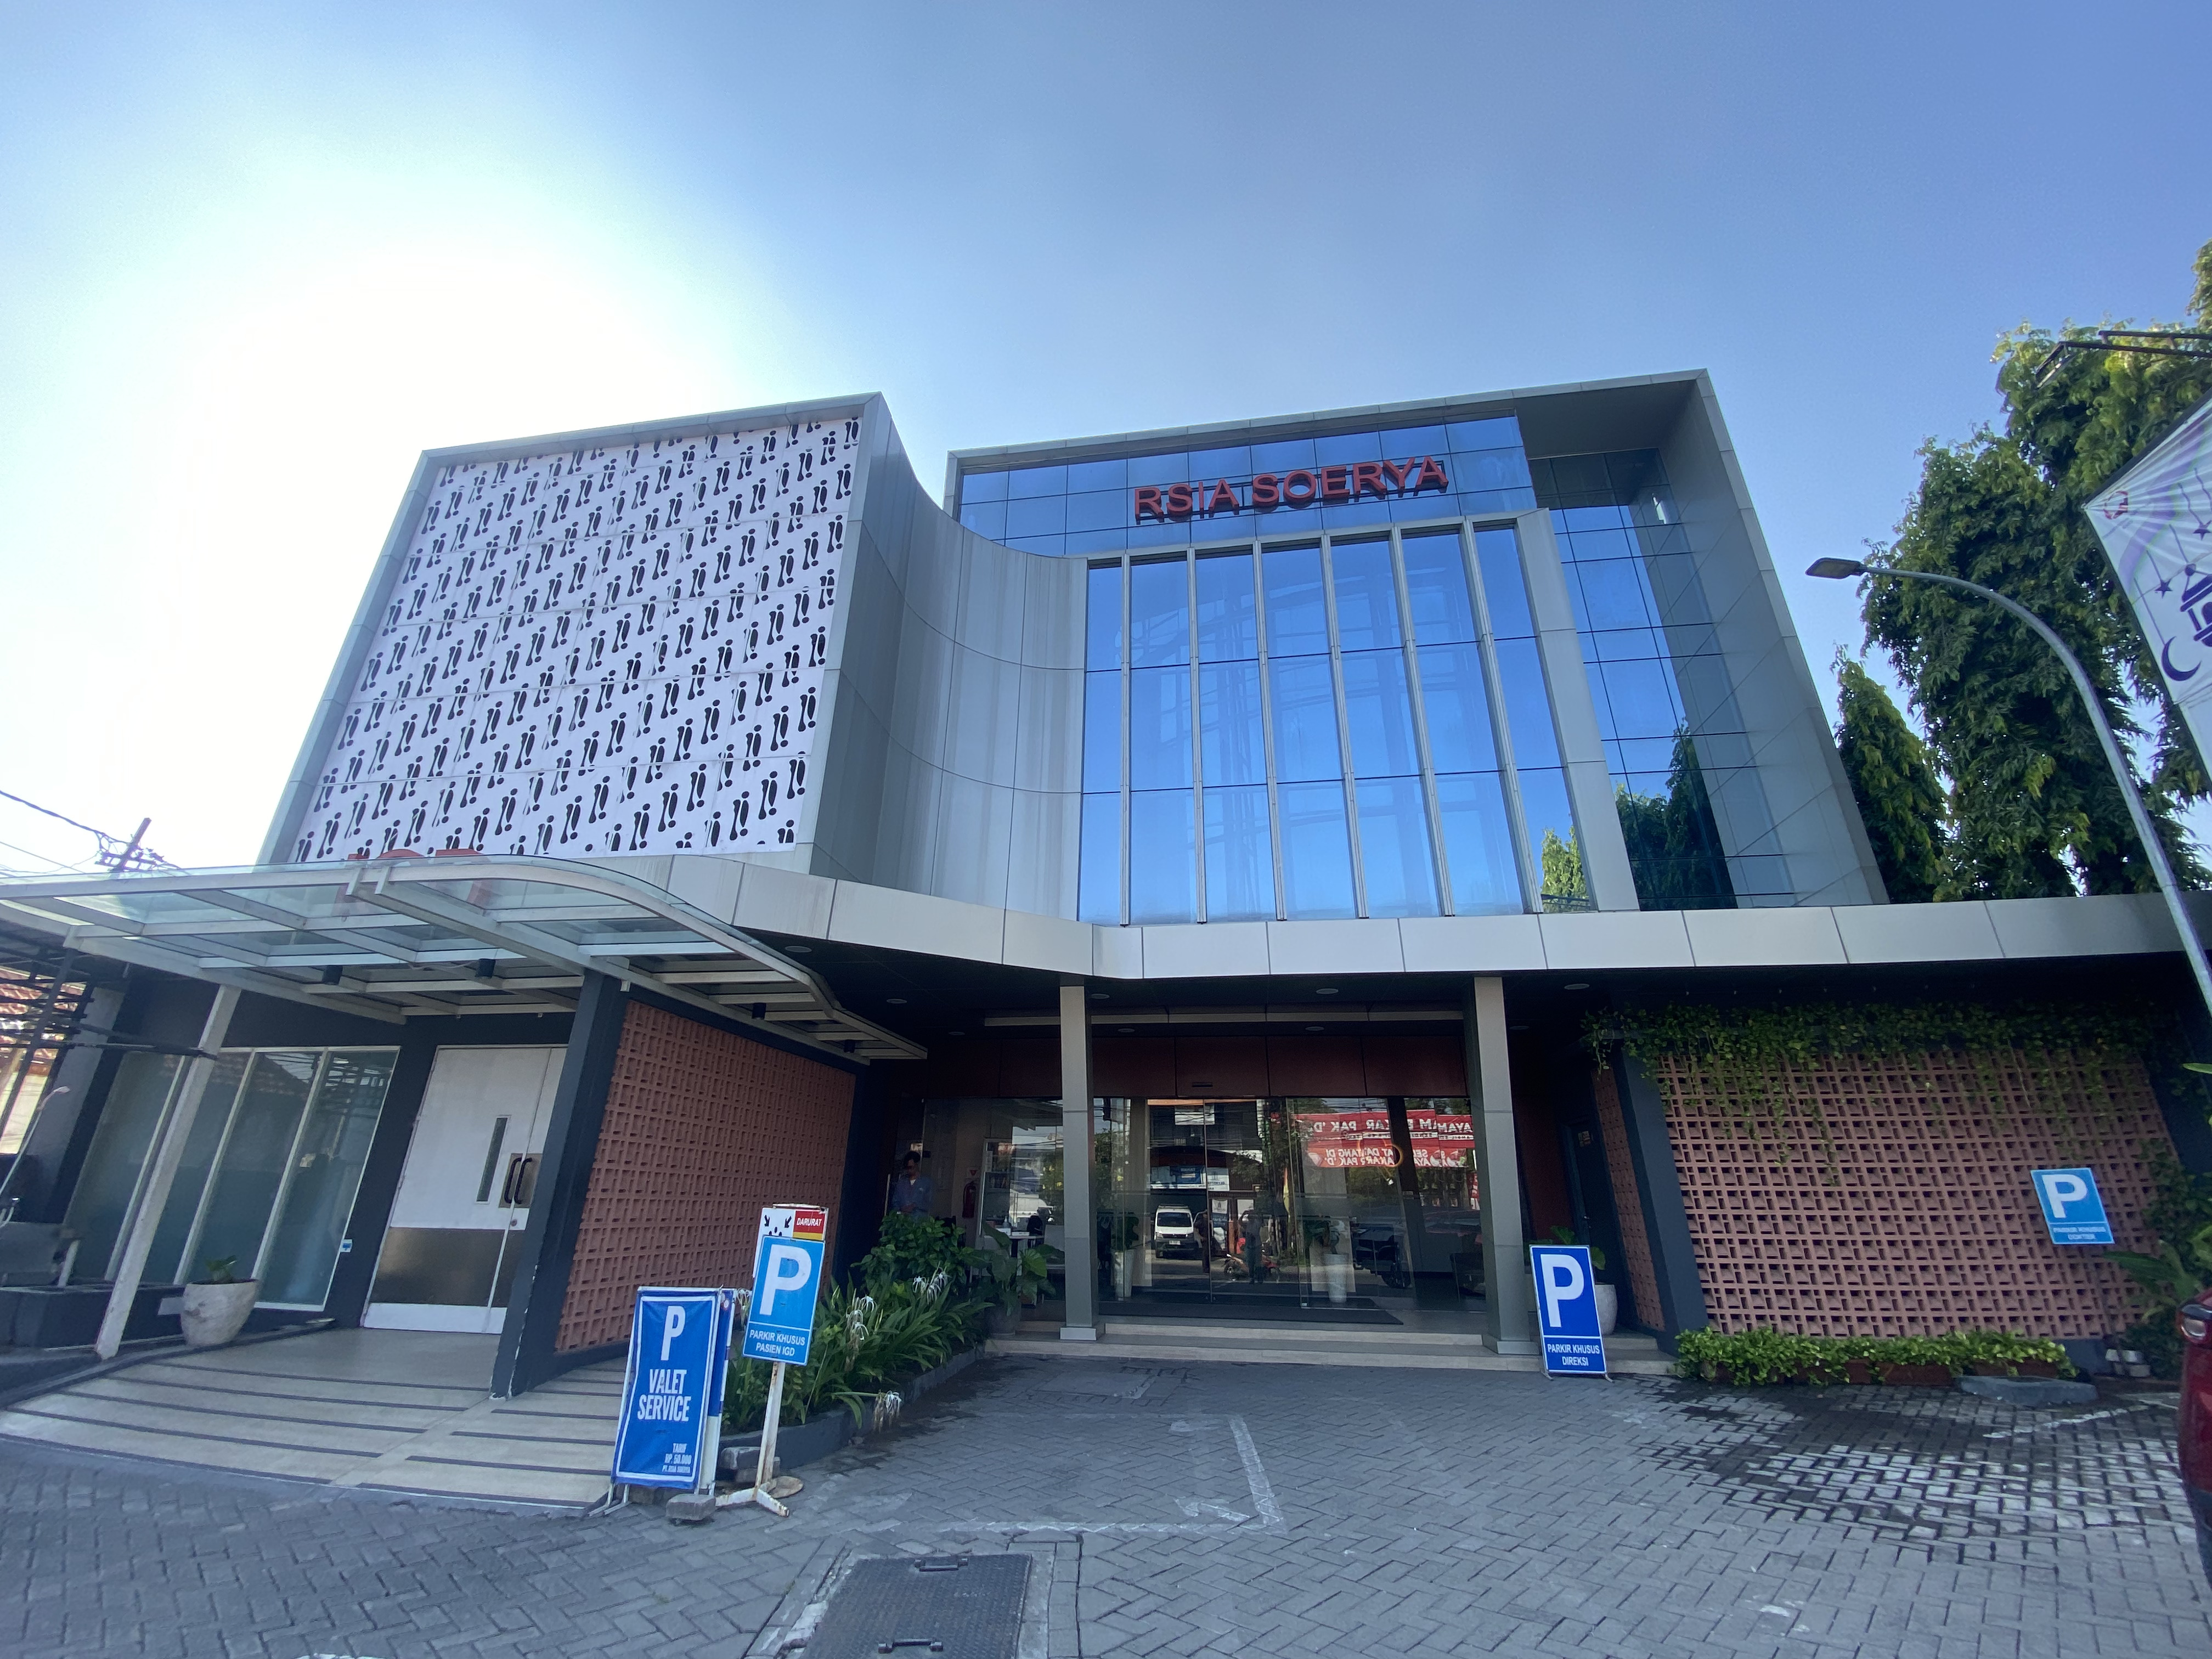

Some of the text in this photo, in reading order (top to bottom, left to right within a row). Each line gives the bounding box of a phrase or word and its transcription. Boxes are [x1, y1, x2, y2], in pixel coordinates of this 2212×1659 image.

[1134, 456, 1448, 521] RSIA SOERYA
[2041, 1174, 2087, 1218] P
[796, 1217, 823, 1227] DARURAT
[760, 1244, 812, 1316] P
[1541, 1254, 1584, 1328] P
[661, 1306, 686, 1361] P
[749, 1329, 805, 1346] PARKIR KHUSUS
[755, 1342, 795, 1356] PASIEN IGD
[1547, 1344, 1600, 1355] PARKIR KHUSUS
[1562, 1356, 1589, 1366] DIREKSI
[649, 1369, 687, 1394] VALET
[637, 1395, 692, 1422] SERVICE
